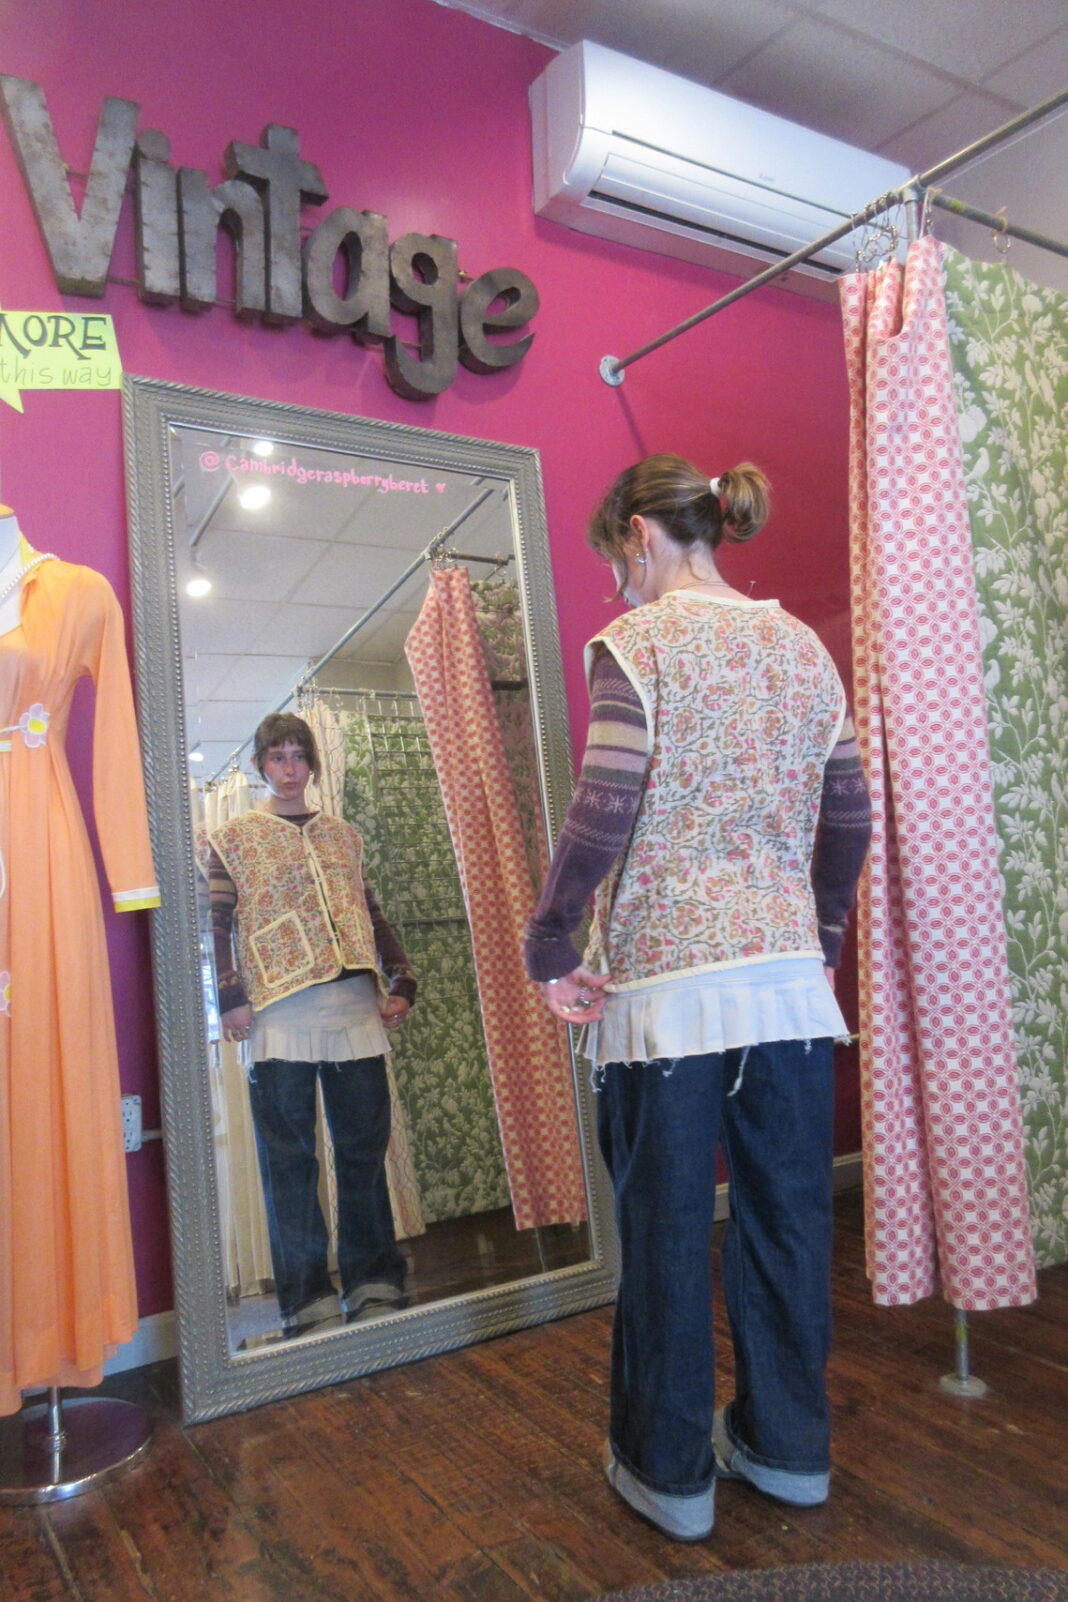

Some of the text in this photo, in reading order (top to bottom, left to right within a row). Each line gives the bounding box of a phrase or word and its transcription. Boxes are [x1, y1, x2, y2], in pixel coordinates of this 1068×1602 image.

[0, 74, 540, 401] Vintage
[0, 355, 112, 387] this way
